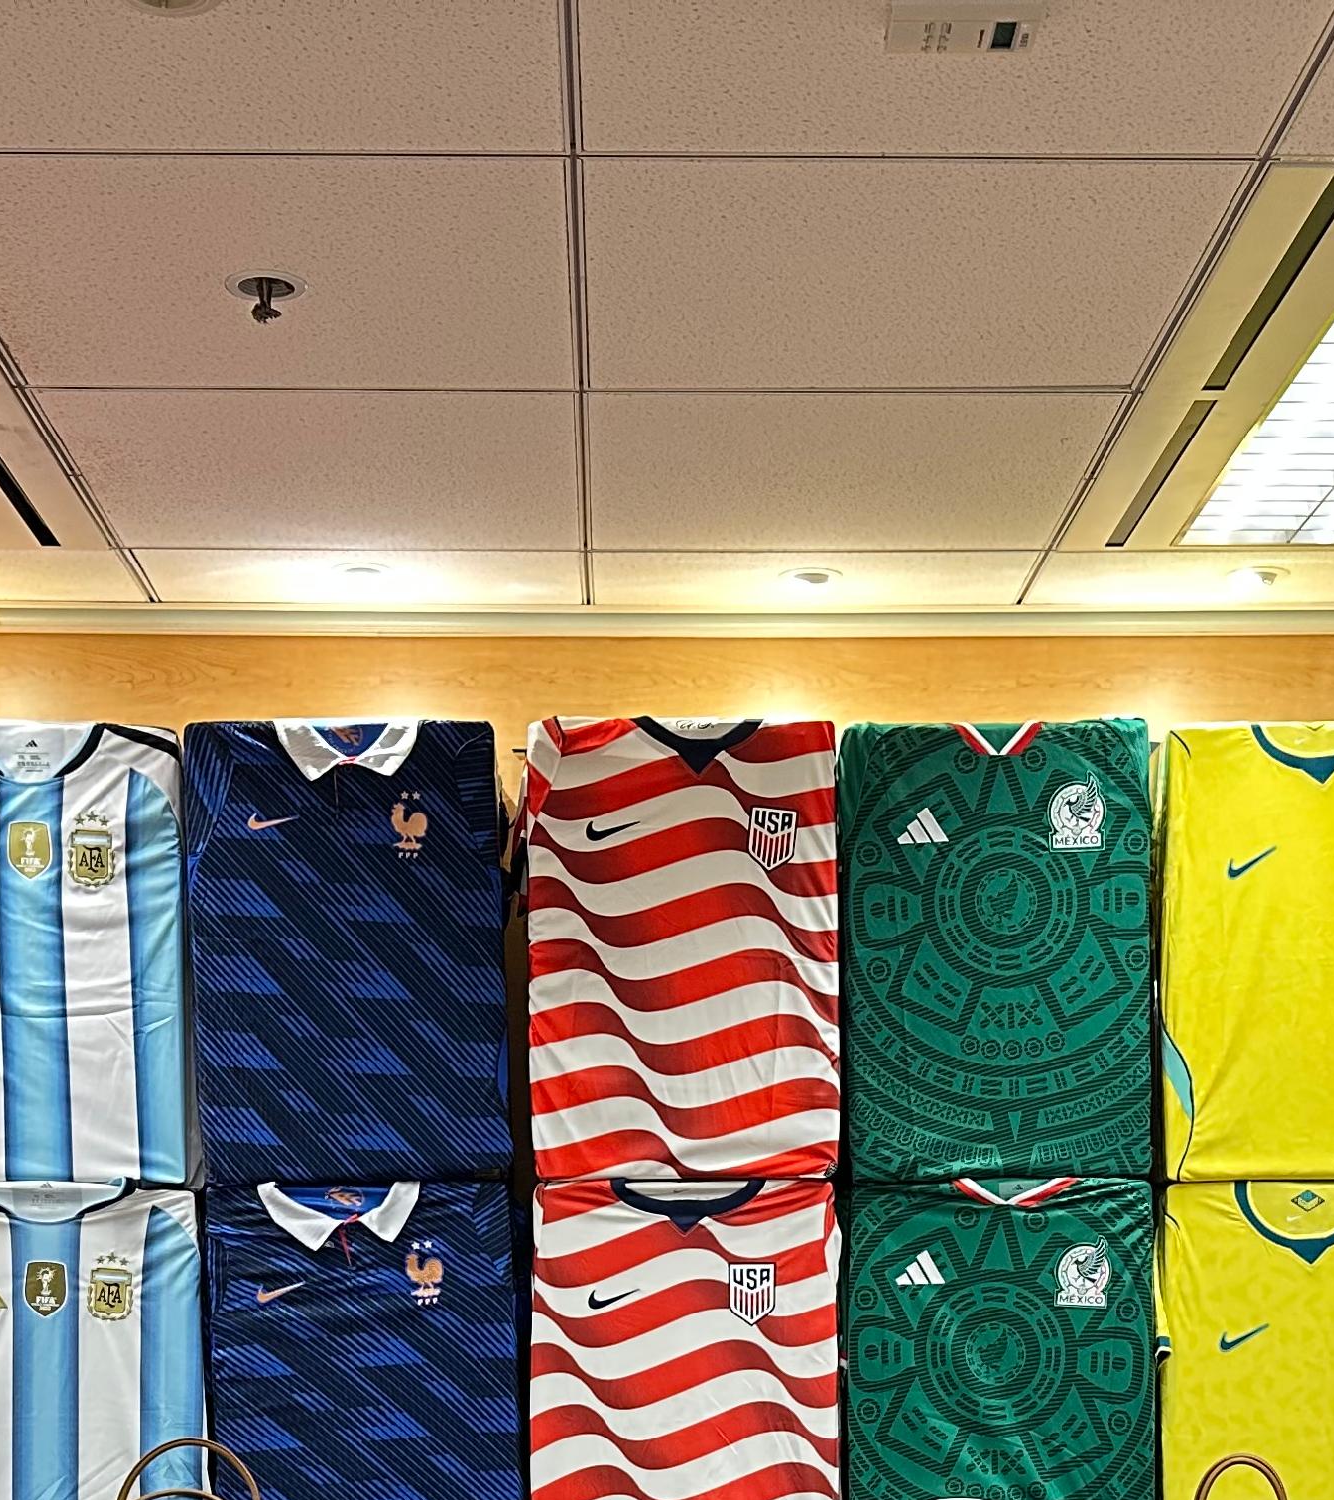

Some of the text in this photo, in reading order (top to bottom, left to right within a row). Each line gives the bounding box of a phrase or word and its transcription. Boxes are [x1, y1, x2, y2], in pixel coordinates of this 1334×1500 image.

[753, 810, 793, 835] USA
[733, 1268, 770, 1290] USA
[35, 1296, 55, 1305] FIFA
